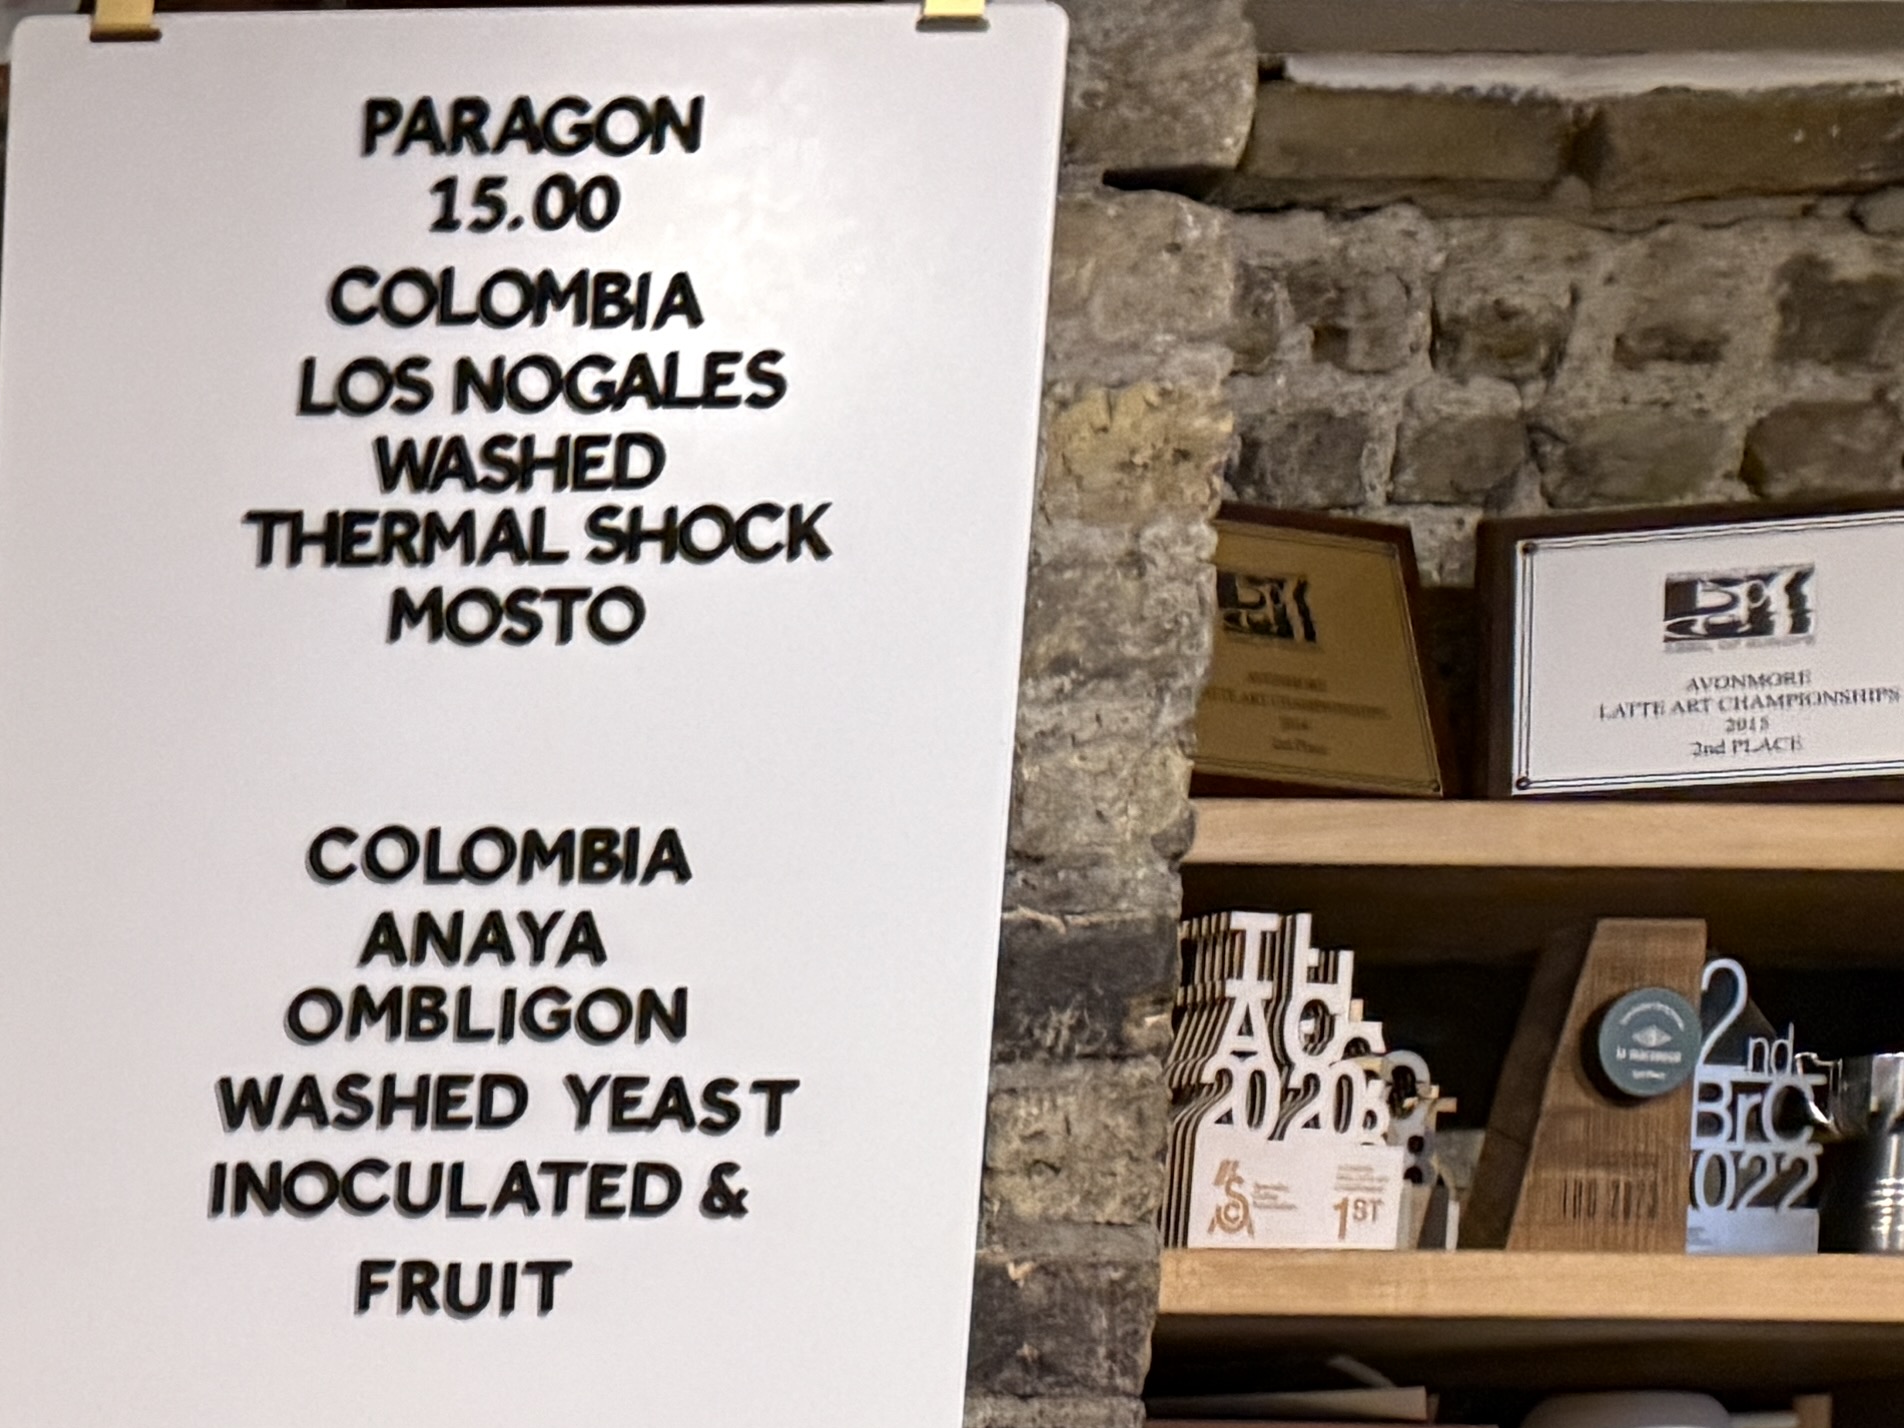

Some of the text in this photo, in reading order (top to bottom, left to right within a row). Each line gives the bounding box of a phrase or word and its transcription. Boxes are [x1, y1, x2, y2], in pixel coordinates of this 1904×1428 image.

[361, 95, 704, 157] PARAGON
[430, 173, 621, 233] 15.00
[327, 265, 704, 330] COLOMBIA
[297, 349, 787, 417] LOS NOGALES
[373, 432, 666, 494] WASHED
[243, 502, 832, 568] THERMAL SHOCK
[388, 585, 646, 647] MOSTO
[1598, 685, 1902, 722] LATTE ART CHAMPIONSHIPS
[1687, 669, 1812, 693] AVONMORE
[1732, 734, 1804, 755] PLACE
[307, 824, 692, 886] COLOMBIA
[359, 910, 607, 967] ANAYA
[286, 984, 688, 1046] OMBLIGON
[217, 1072, 800, 1135] WASHED YEAST
[210, 1158, 748, 1219] INOCULATED &
[357, 1259, 573, 1319] FRUIT
